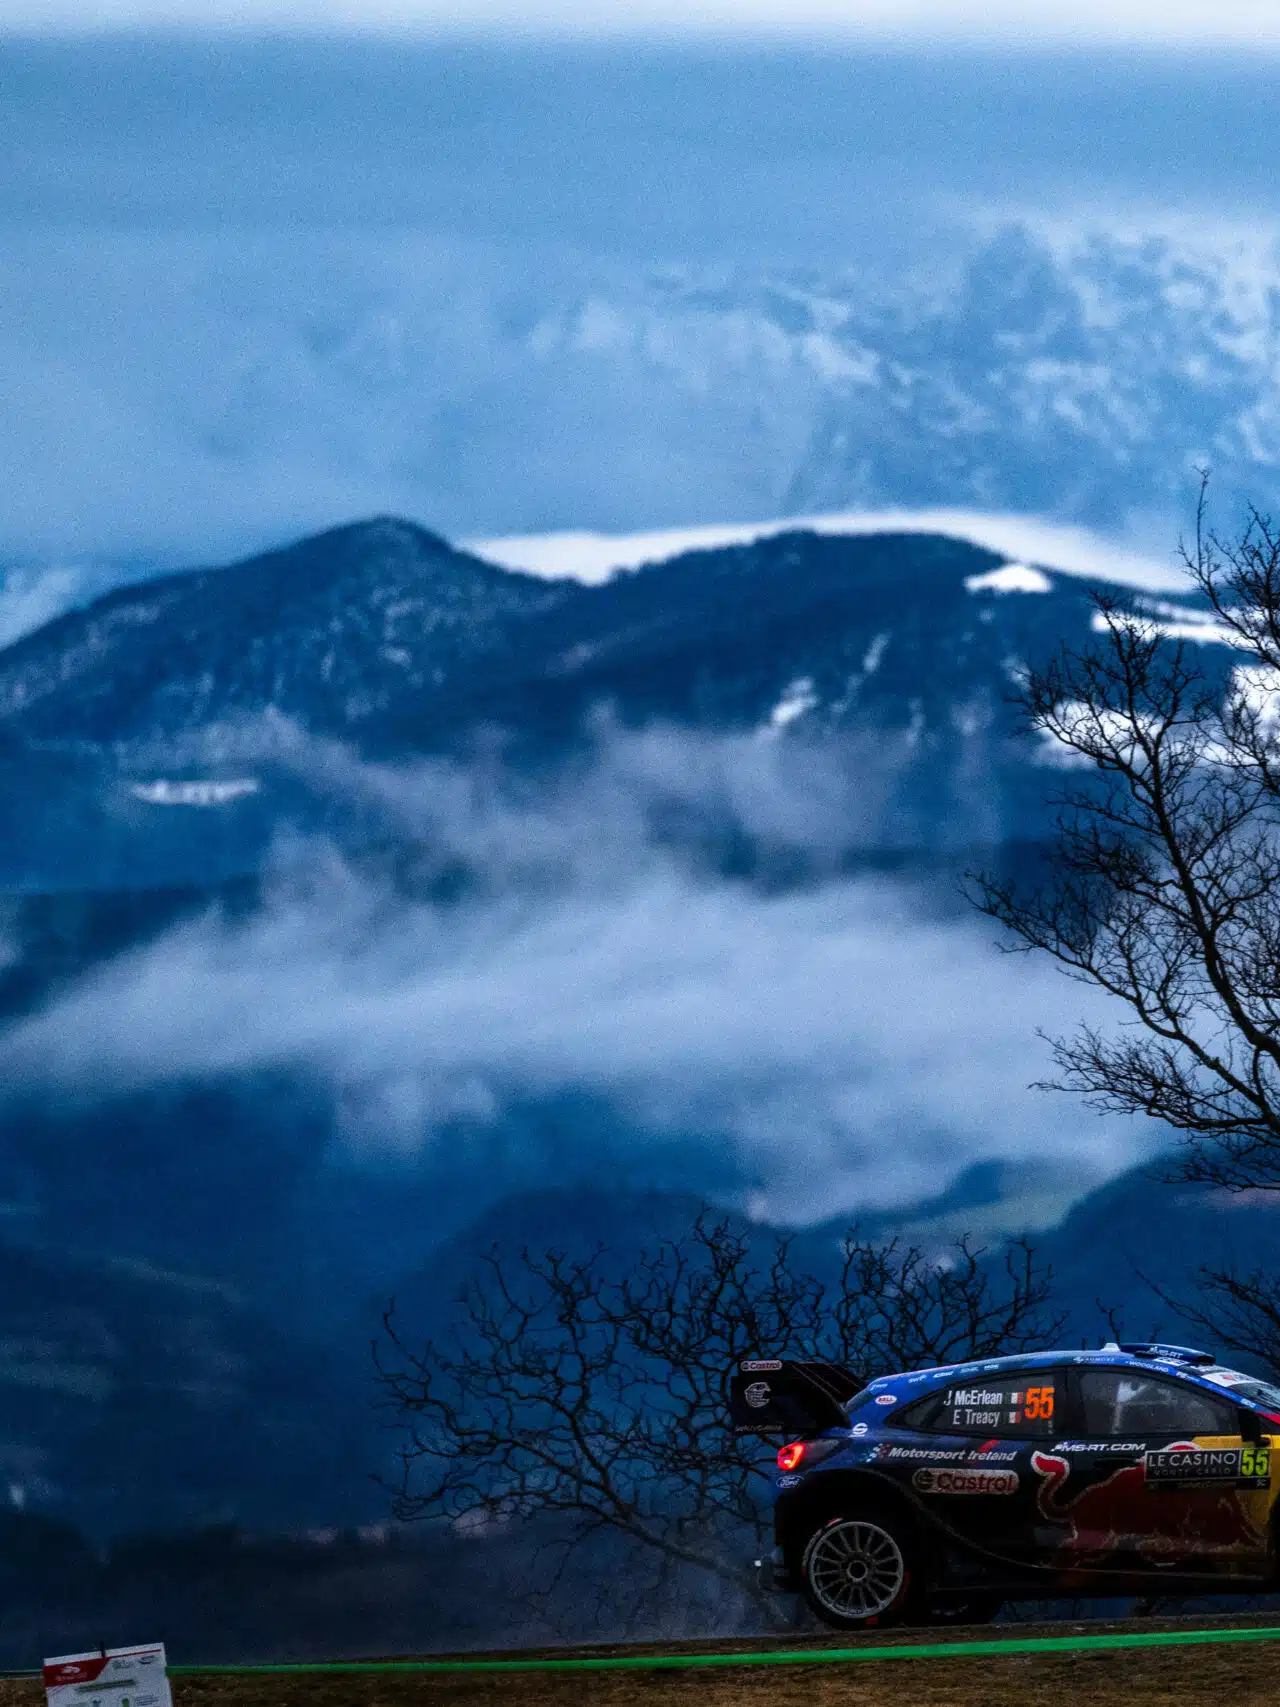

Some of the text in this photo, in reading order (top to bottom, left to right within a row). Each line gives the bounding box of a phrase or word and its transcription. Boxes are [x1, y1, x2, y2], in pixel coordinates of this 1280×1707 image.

[750, 1361, 780, 1370] Castrol
[944, 1389, 1003, 1406] J McErlean
[1024, 1387, 1055, 1419] 55
[953, 1408, 1000, 1427] E Treacy
[888, 1447, 1017, 1462] Motorsport Ireland
[1148, 1452, 1237, 1467] LE CASINO
[1241, 1449, 1269, 1476] 55
[936, 1472, 1014, 1492] Castrol
